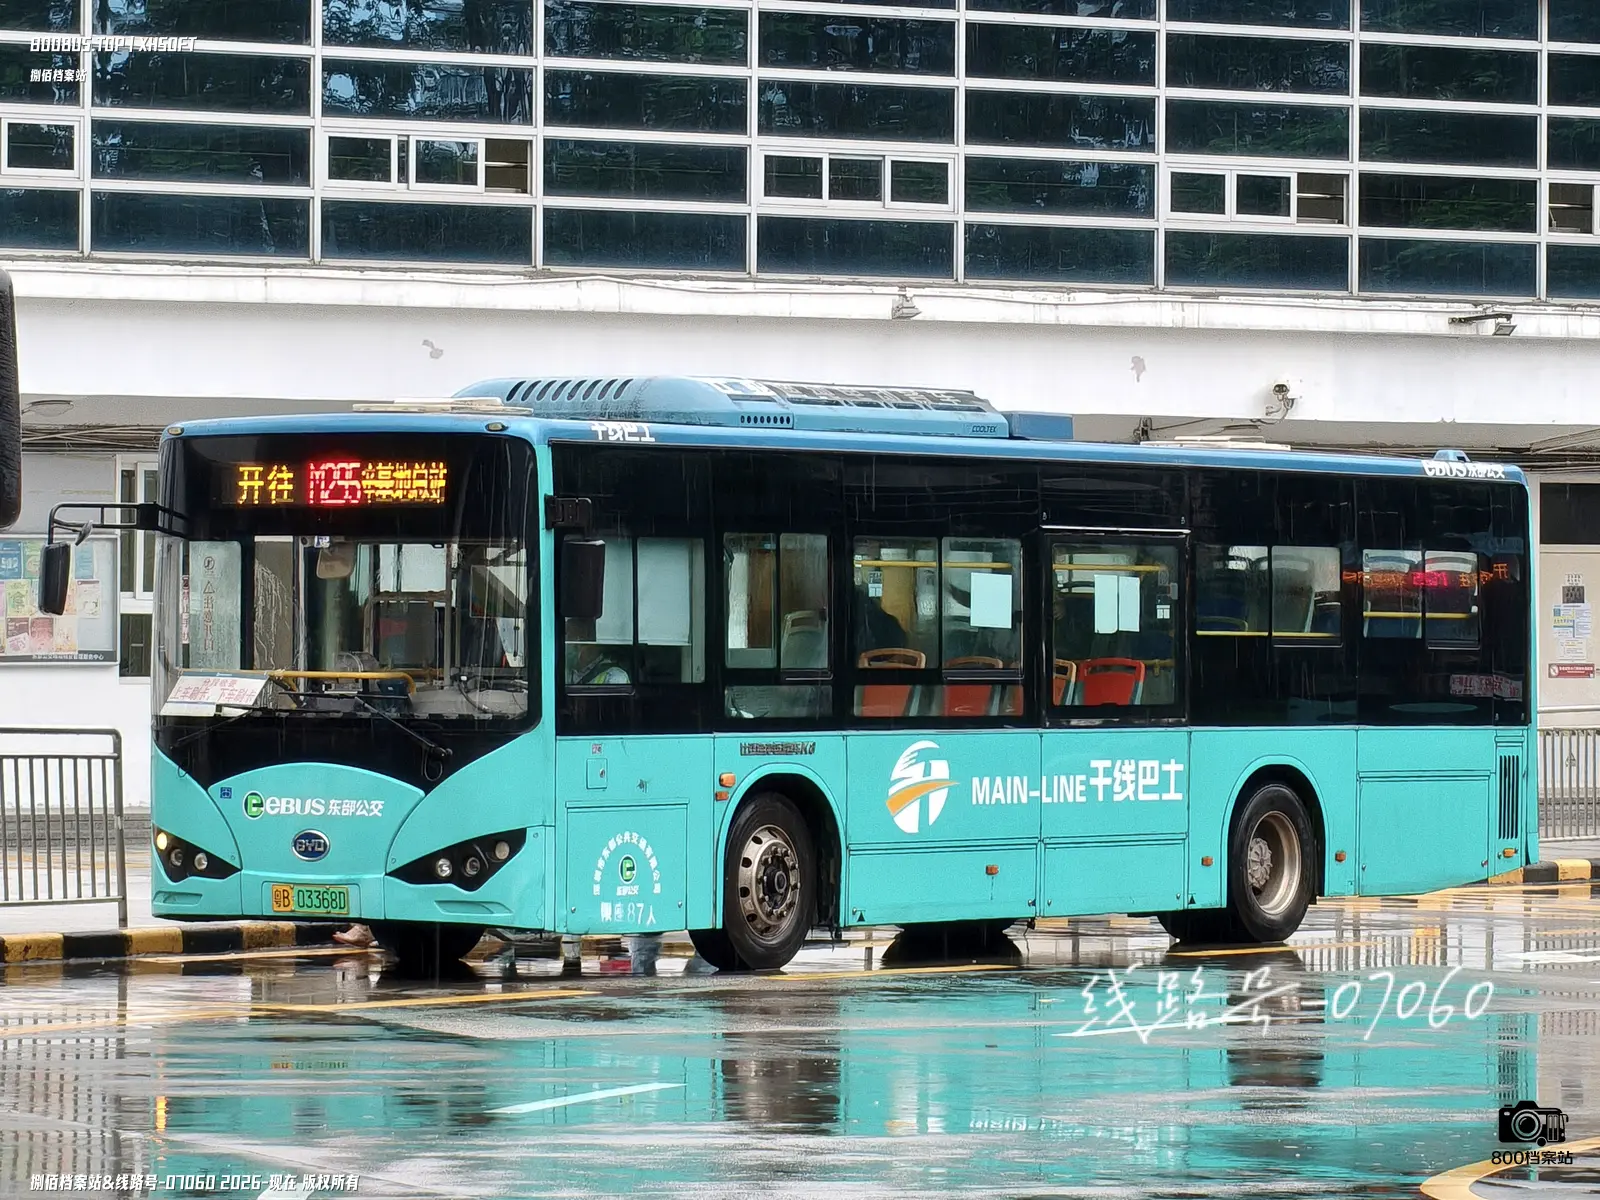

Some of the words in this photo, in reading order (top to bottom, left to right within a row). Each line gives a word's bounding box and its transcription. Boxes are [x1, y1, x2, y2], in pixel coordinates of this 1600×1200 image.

[238, 465, 294, 504] 开往
[971, 775, 1087, 805] MAIN-LINE
[1089, 758, 1184, 802] 干线巴士
[327, 799, 385, 817] 东部公交
[296, 839, 325, 852] BYD
[273, 889, 291, 908] 粤B
[297, 889, 346, 910] 03368D
